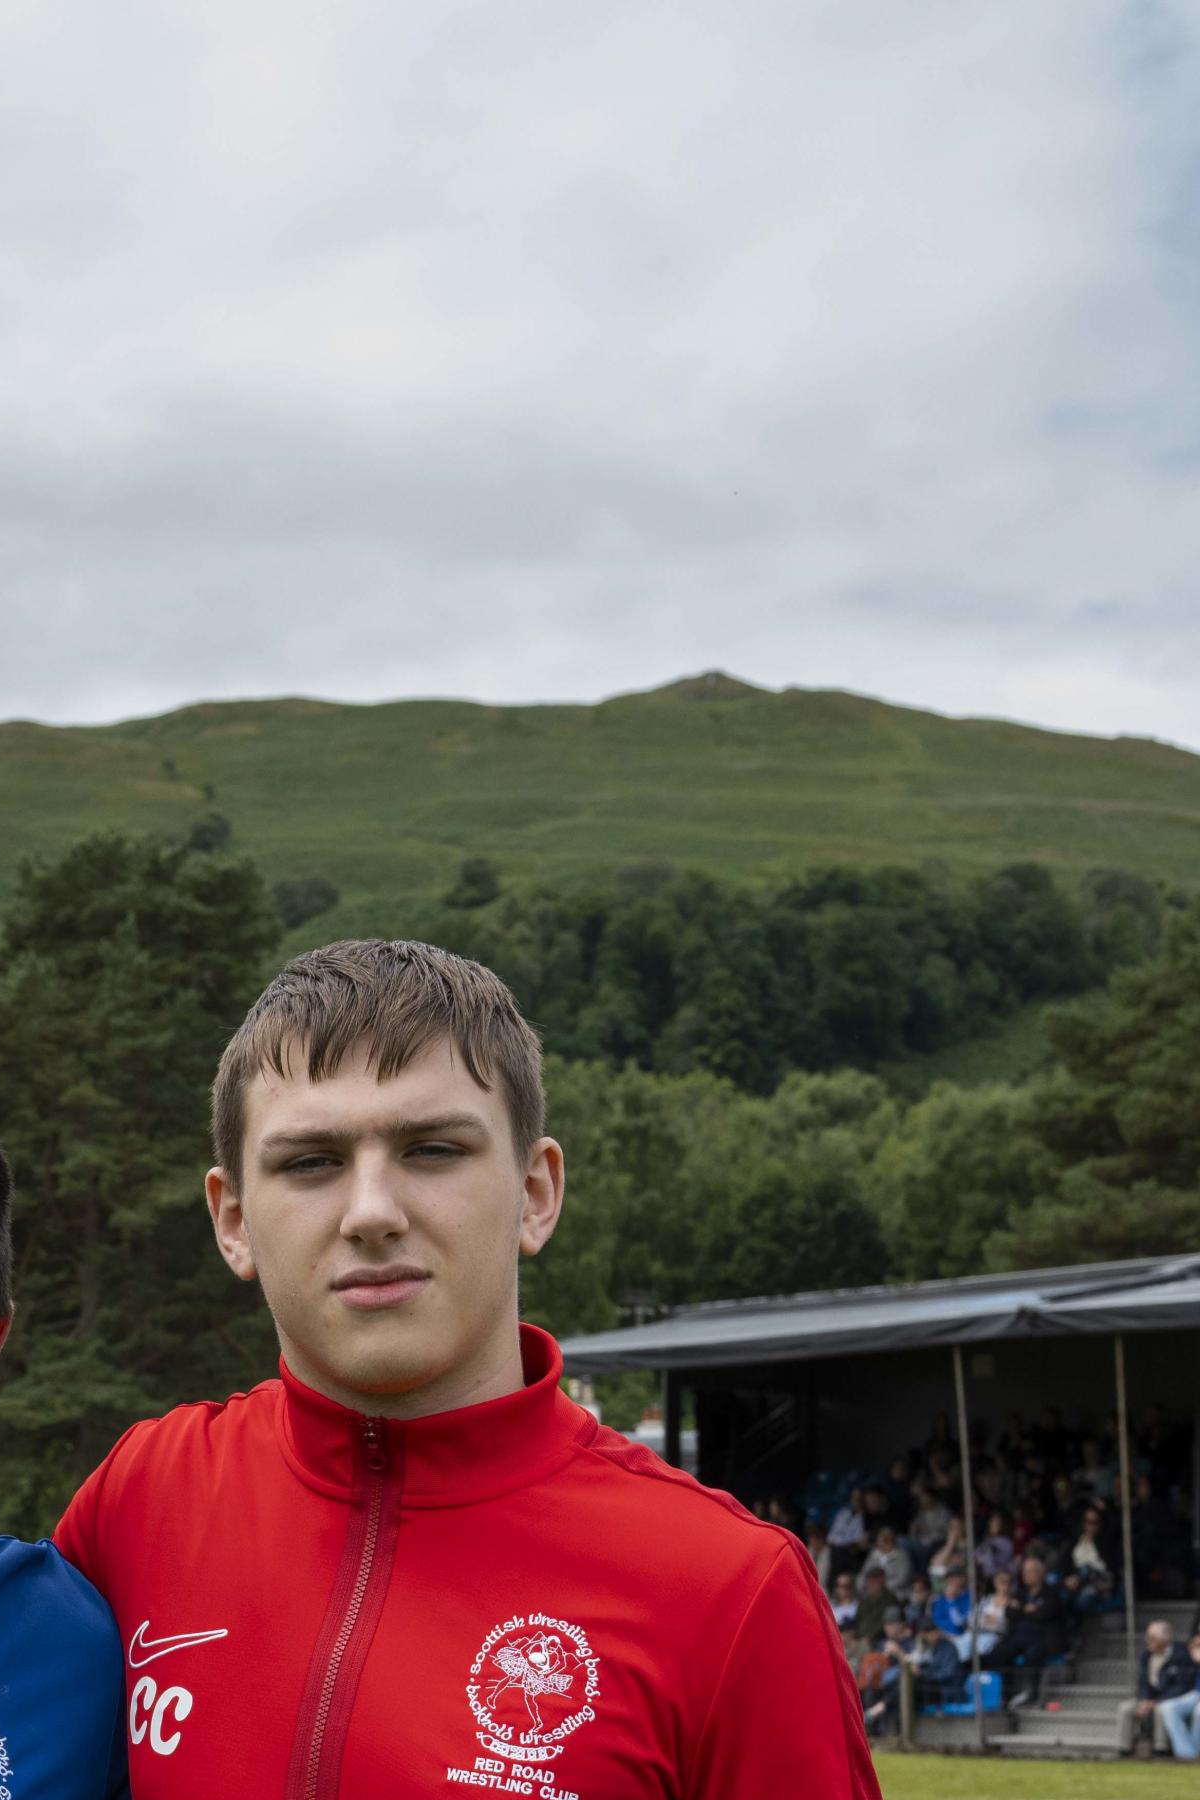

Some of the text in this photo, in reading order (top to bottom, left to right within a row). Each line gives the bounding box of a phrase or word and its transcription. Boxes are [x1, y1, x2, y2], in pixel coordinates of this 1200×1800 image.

[130, 1676, 193, 1756] CC
[446, 1767, 533, 1795] WRESTLING
[474, 1757, 555, 1784] RED ROAD
